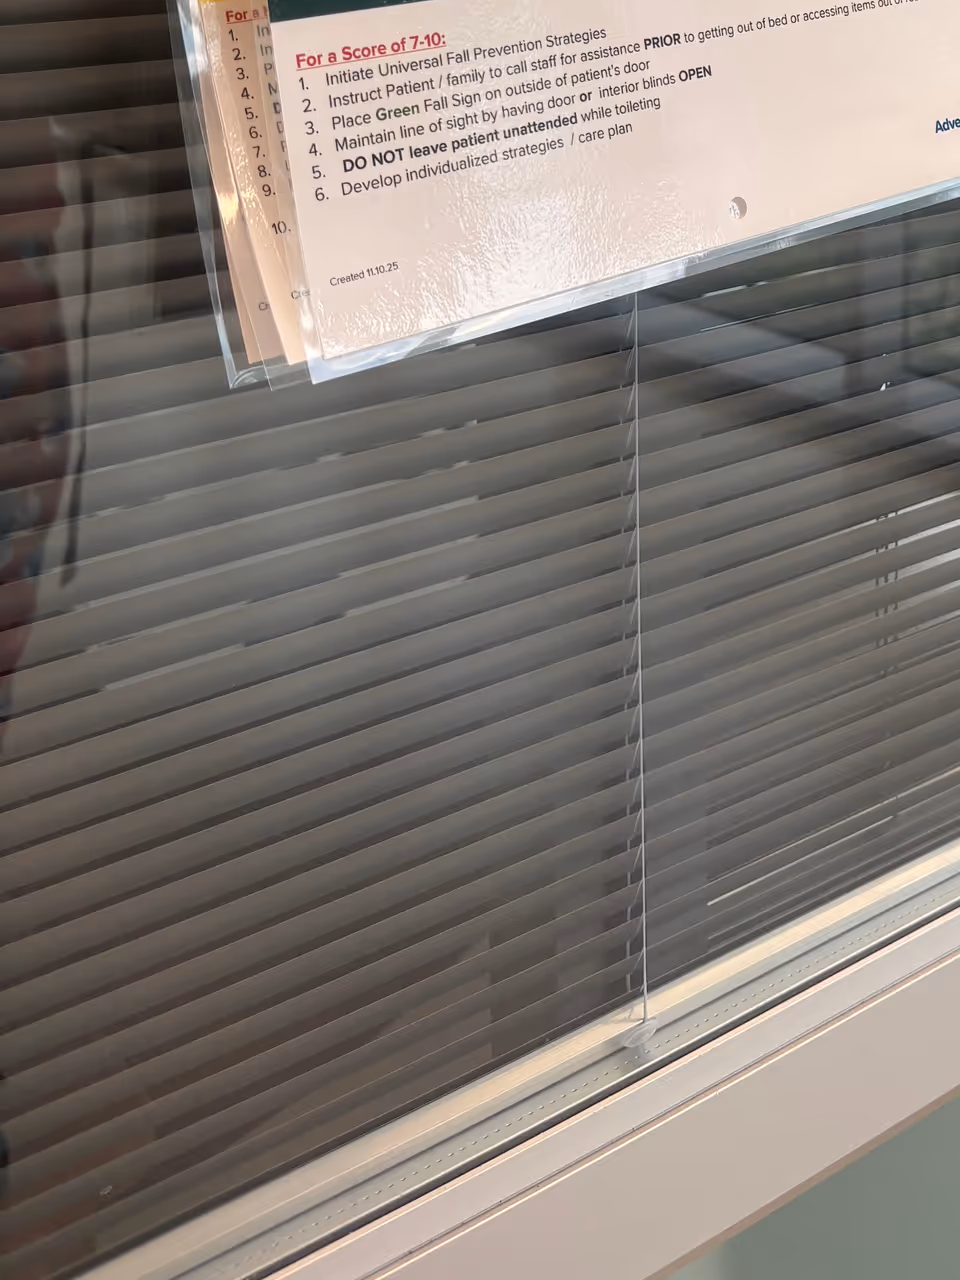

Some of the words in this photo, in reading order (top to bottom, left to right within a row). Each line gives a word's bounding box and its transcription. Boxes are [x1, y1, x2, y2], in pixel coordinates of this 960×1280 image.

[226, 10, 248, 22] For
[229, 29, 238, 41] 1.
[232, 48, 246, 60] 2.
[296, 53, 322, 68] For
[328, 52, 337, 63] a
[342, 44, 386, 61] Score
[391, 38, 406, 55] of
[409, 32, 446, 51] 7-10:
[302, 99, 316, 113] 2.
[328, 88, 382, 108] Instruct
[386, 78, 435, 96] Patient
[438, 74, 443, 88] /
[446, 70, 485, 89] family
[488, 67, 502, 78] to
[506, 60, 528, 75] call
[531, 55, 557, 71] staff
[560, 52, 576, 65] for
[580, 41, 640, 62] assistance
[644, 33, 681, 50] PRIOR
[684, 32, 694, 42] to
[698, 24, 734, 44] getting
[738, 22, 754, 34] out
[756, 18, 766, 30] of
[768, 14, 788, 28] bed
[790, 13, 800, 24] or
[803, 4, 849, 23] accessing
[851, 0, 876, 12] items
[299, 77, 309, 90] 1.
[326, 67, 373, 86] Initiate
[378, 55, 443, 76] Universal
[447, 51, 470, 64] Fall
[474, 40, 542, 60] Prevention
[546, 28, 606, 49] Strategies
[236, 68, 248, 80] 3.
[241, 87, 254, 99] 4.
[305, 121, 320, 136] 3.
[332, 113, 371, 130] Place
[376, 104, 420, 121] Green
[424, 97, 448, 112] Fall
[452, 93, 482, 111] Sign
[485, 91, 501, 102] on
[506, 79, 552, 98] outside
[556, 74, 568, 88] of
[571, 64, 620, 86] patient's
[624, 59, 650, 76] door
[245, 107, 258, 120] 5.
[309, 144, 322, 156] 4.
[335, 130, 396, 152] Maintain
[400, 124, 424, 140] line
[429, 120, 442, 134] of
[446, 113, 479, 131] sight
[482, 110, 498, 124] by
[502, 100, 544, 120] having
[547, 94, 576, 110] door
[580, 91, 592, 103] or
[599, 80, 640, 98] interior
[643, 74, 676, 90] blinds
[678, 64, 712, 82] OPEN
[249, 126, 262, 138] 6.
[312, 166, 326, 179] 5.
[343, 156, 367, 172] DO
[372, 148, 404, 166] NOT
[410, 142, 448, 158] leave
[452, 130, 500, 152] patient
[503, 112, 578, 139] unattended
[581, 105, 612, 122] while
[614, 96, 661, 118] toileting
[253, 146, 265, 158] 7.
[315, 188, 329, 202] 6.
[341, 173, 402, 196] Develop
[406, 150, 498, 182] individualized
[502, 136, 564, 162] strategies
[578, 130, 604, 143] care
[608, 123, 632, 140] plan
[258, 165, 271, 177] 8.
[262, 184, 276, 196] 9.
[272, 221, 291, 234] 10.
[330, 270, 364, 286] Created
[366, 261, 398, 277] 11.10.25
